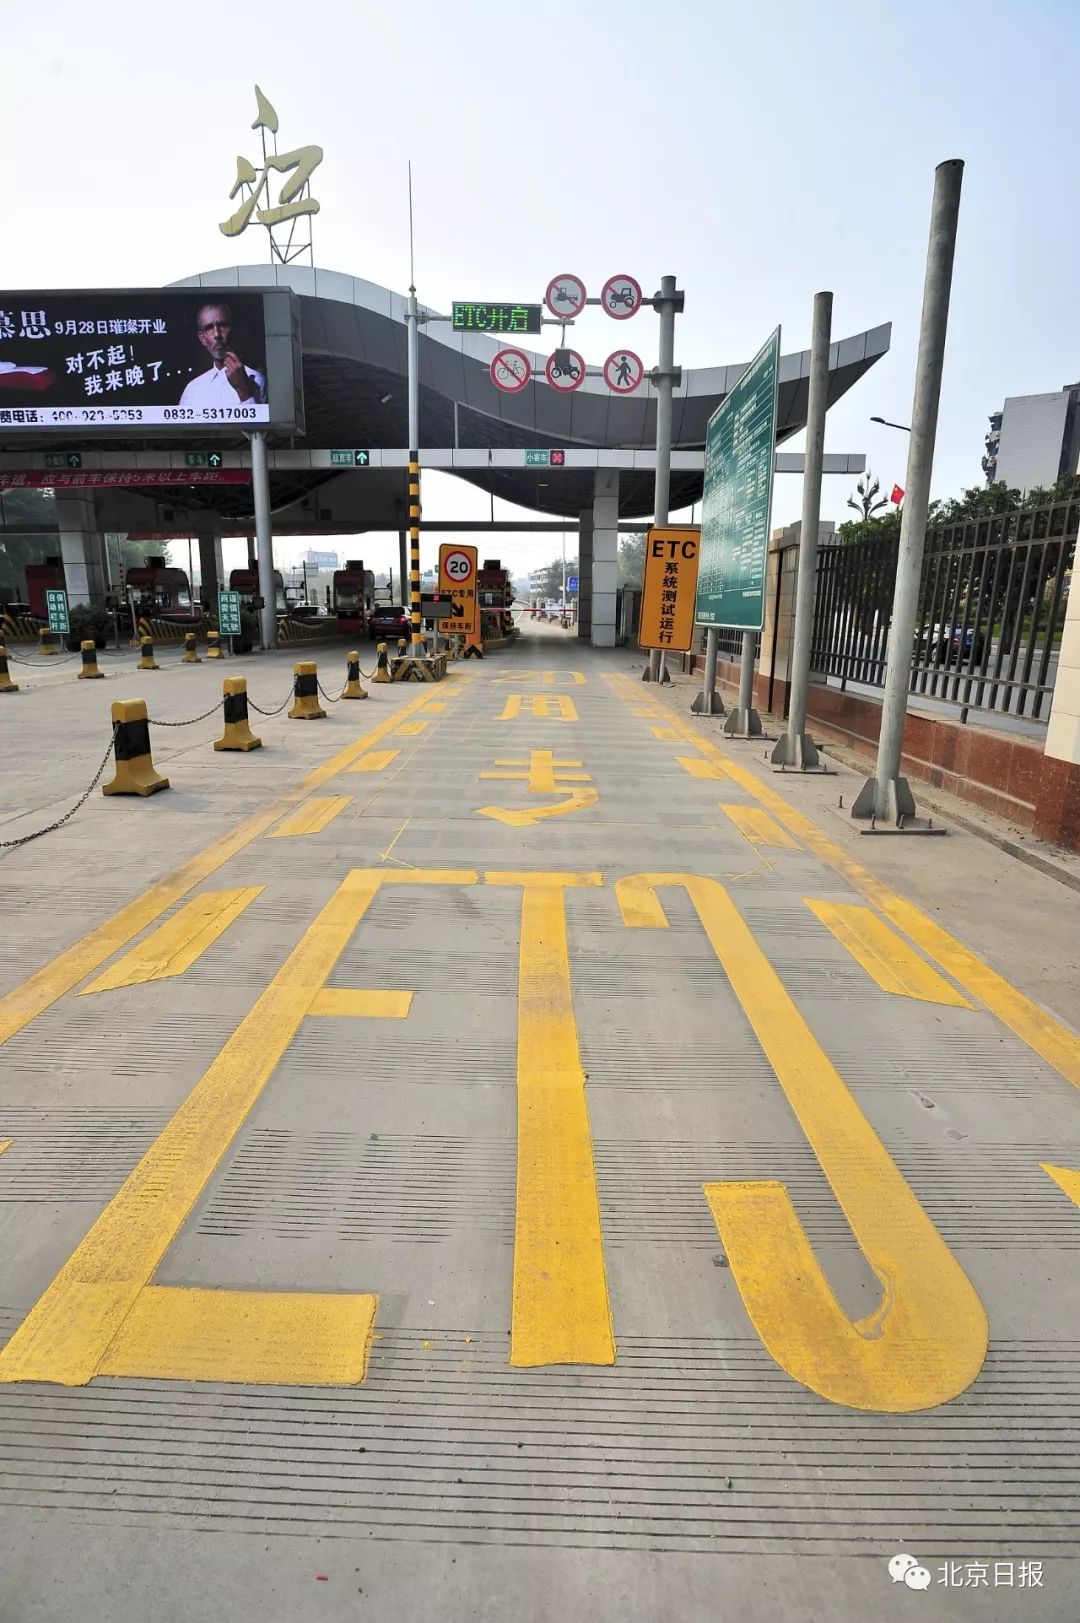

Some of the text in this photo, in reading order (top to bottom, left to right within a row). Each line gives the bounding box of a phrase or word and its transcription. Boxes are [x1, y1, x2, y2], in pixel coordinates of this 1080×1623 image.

[454, 305, 529, 331] ETC开启
[54, 318, 167, 336] 9月28日璀璨开业
[163, 408, 257, 420] 0832-5317003
[527, 452, 548, 462] 小客车
[653, 540, 697, 560] ETC
[449, 560, 468, 574] 20
[658, 562, 680, 644] 系统测试运行
[441, 622, 472, 630] 保持车距
